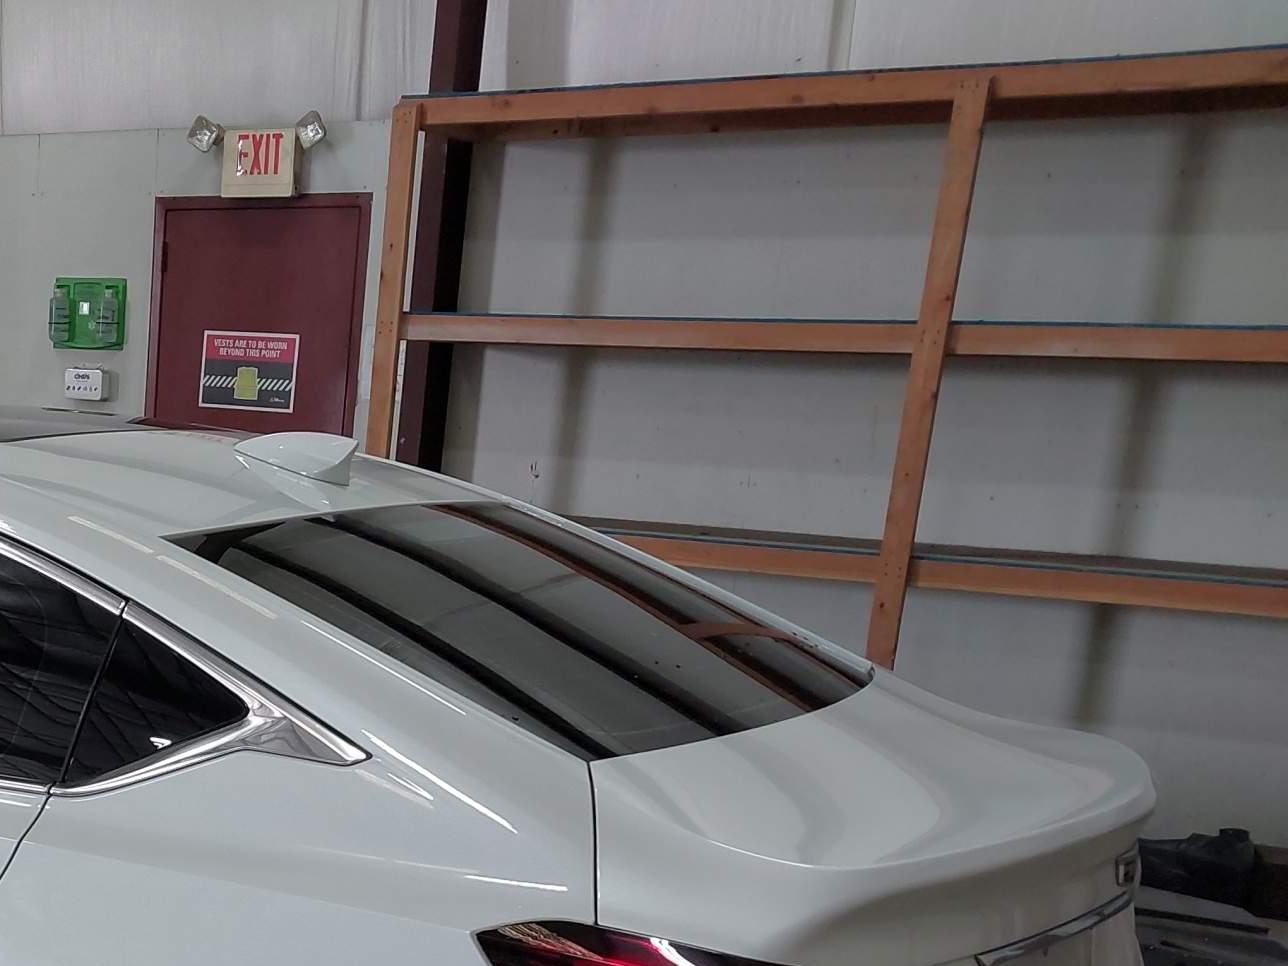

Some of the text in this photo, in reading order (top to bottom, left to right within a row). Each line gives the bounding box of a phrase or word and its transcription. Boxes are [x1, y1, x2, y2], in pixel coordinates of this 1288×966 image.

[236, 133, 284, 176] EXIT
[214, 339, 233, 347] VESTS
[234, 340, 247, 348] ARE
[257, 341, 266, 349] BE
[267, 341, 288, 350] WORN
[219, 347, 280, 358] BEYOND THIS POINT
